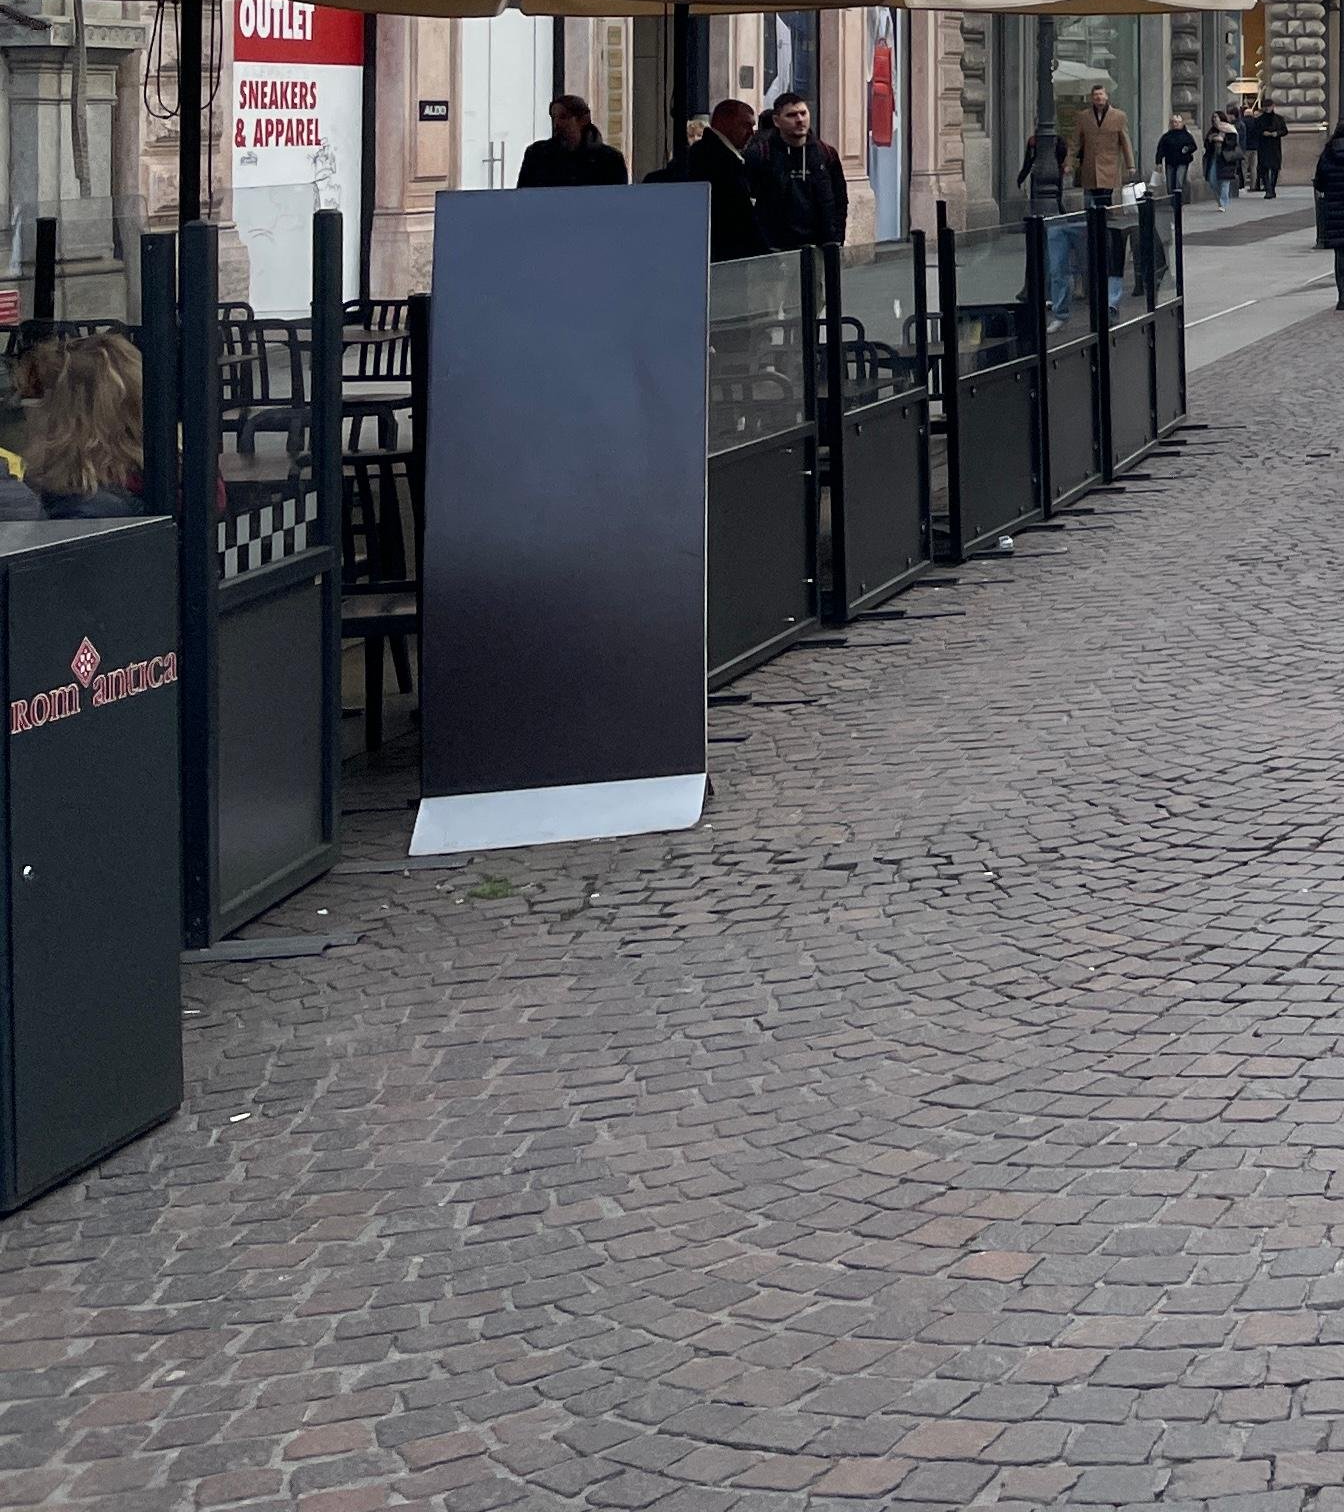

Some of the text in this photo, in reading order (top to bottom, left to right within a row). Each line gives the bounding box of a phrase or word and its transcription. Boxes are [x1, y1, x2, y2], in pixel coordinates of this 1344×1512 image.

[239, 79, 317, 110] SNEAKERS
[423, 104, 447, 116] ALDO
[234, 117, 322, 148] & APPAREL
